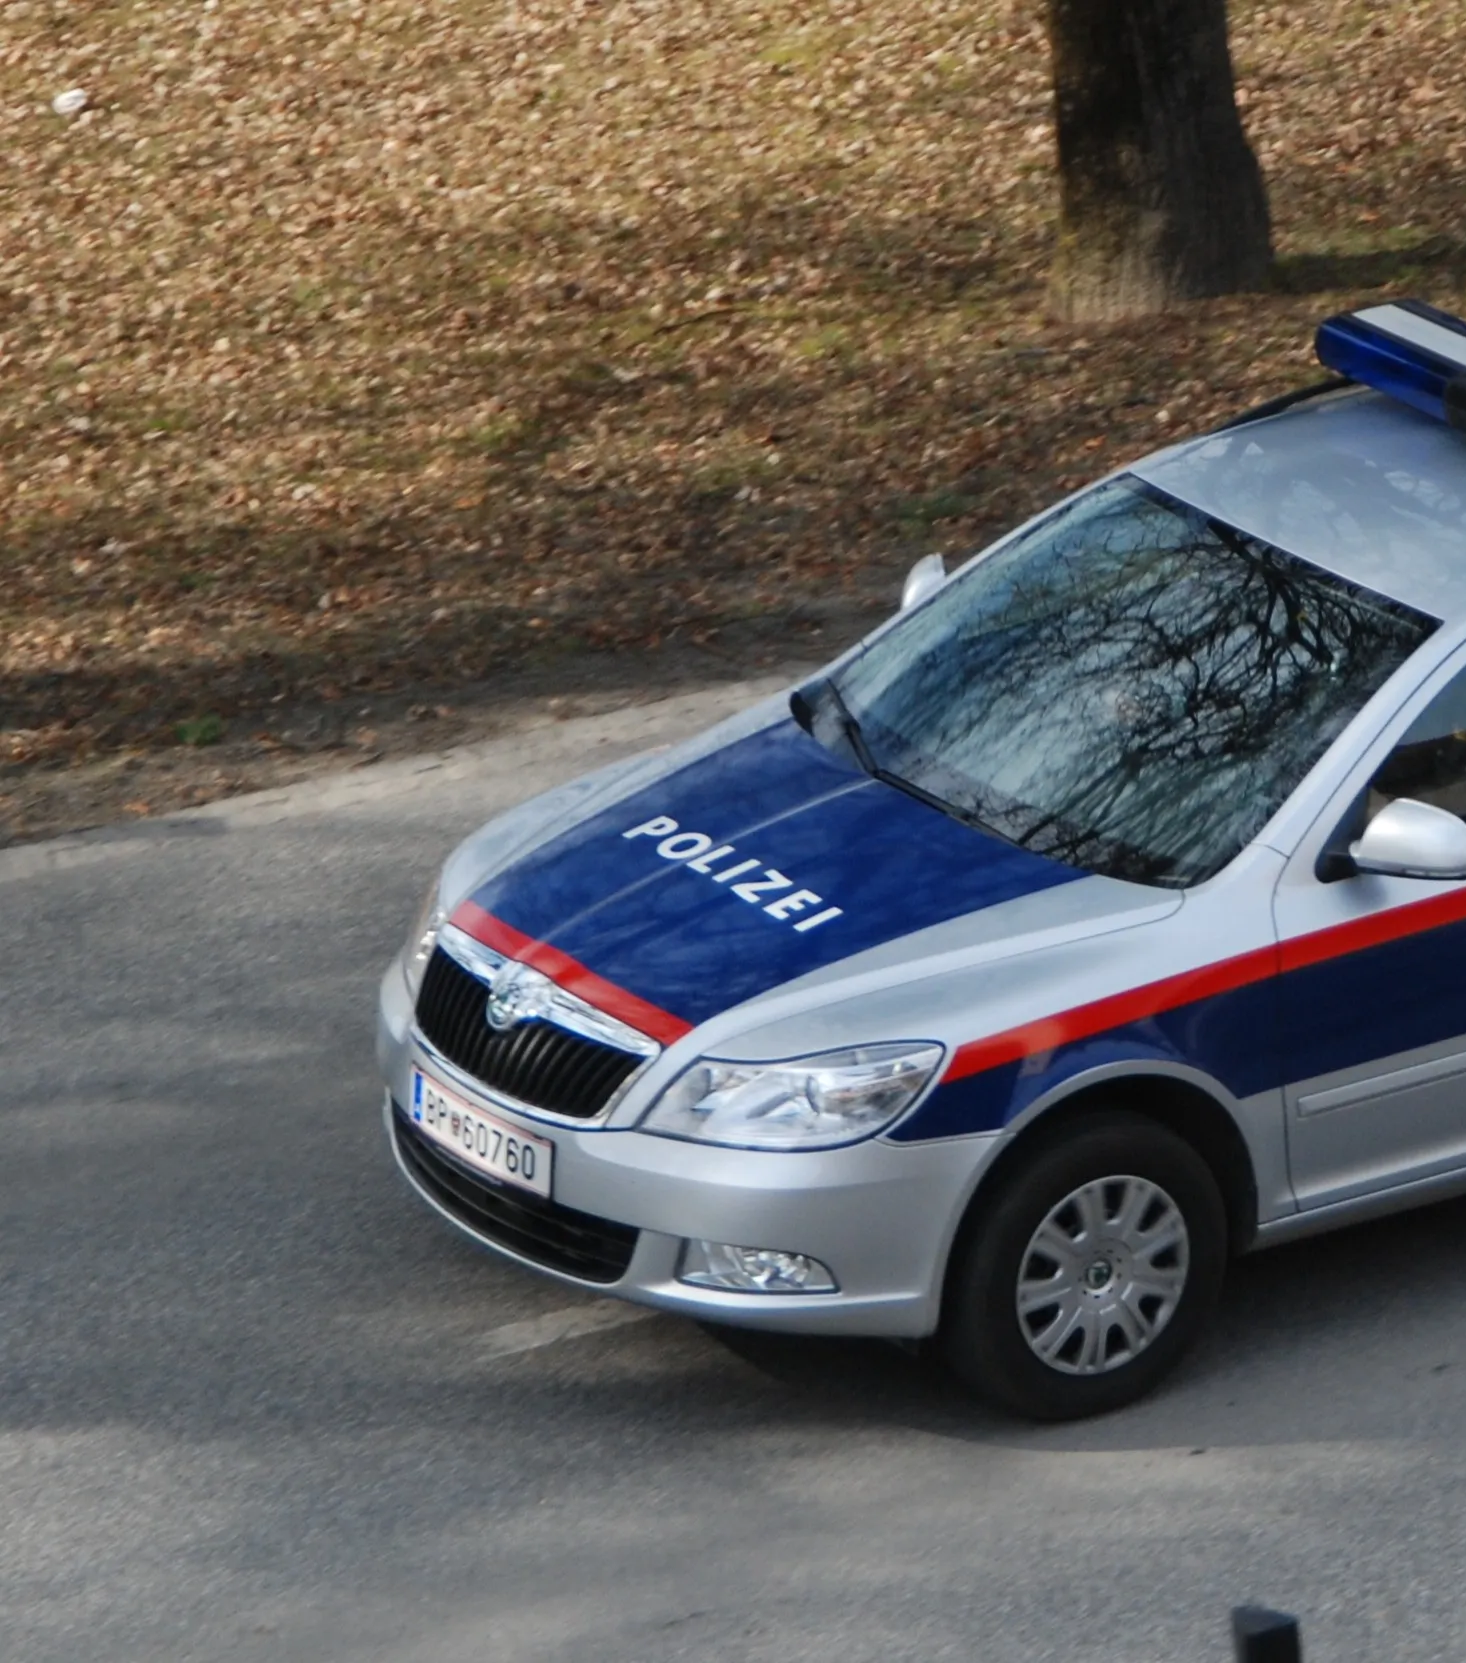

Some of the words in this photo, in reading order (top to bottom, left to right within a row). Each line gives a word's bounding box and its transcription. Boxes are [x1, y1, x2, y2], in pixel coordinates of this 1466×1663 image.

[621, 815, 844, 933] POLIZEI
[425, 1087, 448, 1132] BP
[462, 1114, 536, 1181] 60760
